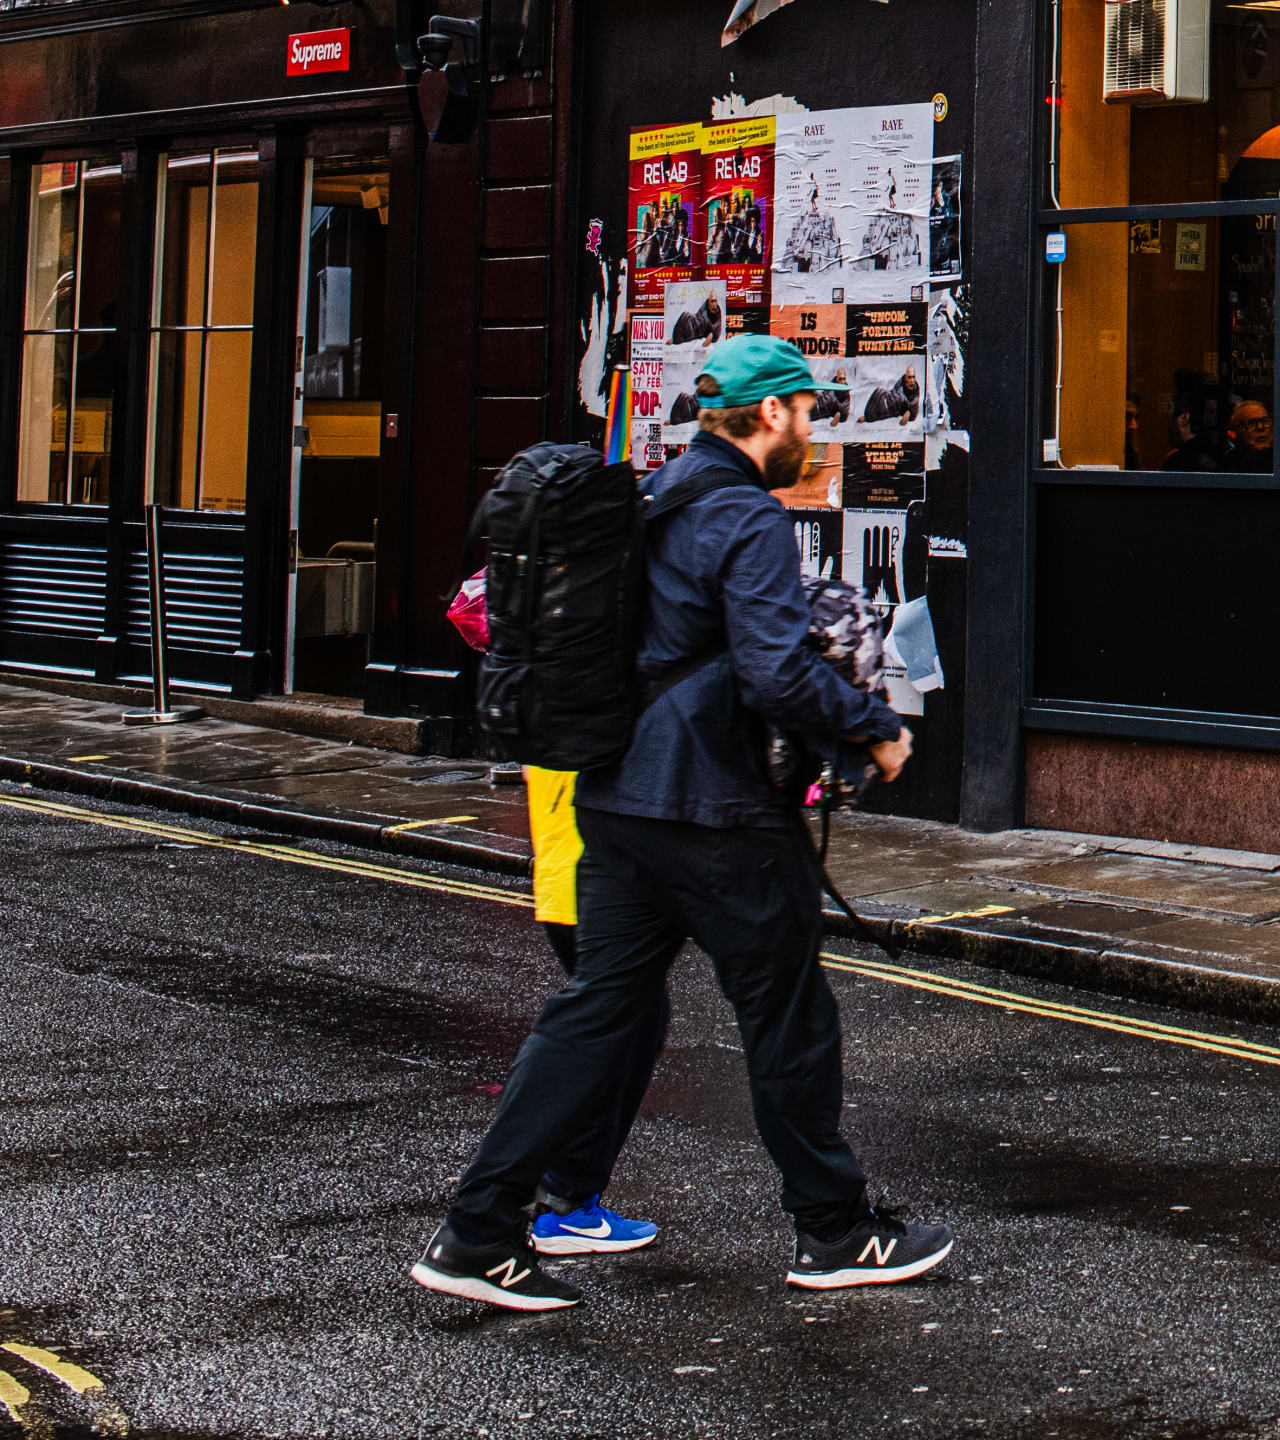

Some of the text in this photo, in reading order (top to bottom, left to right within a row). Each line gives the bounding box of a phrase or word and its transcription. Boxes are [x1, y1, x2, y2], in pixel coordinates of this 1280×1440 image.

[291, 39, 342, 70] Supreme
[804, 124, 825, 137] RAYE
[882, 119, 904, 131] RAYE
[800, 312, 817, 331] IS
[862, 325, 912, 338] FORTABLY
[780, 336, 840, 355] NDON
[858, 339, 915, 352] FUNNY AND
[633, 377, 642, 388] 17
